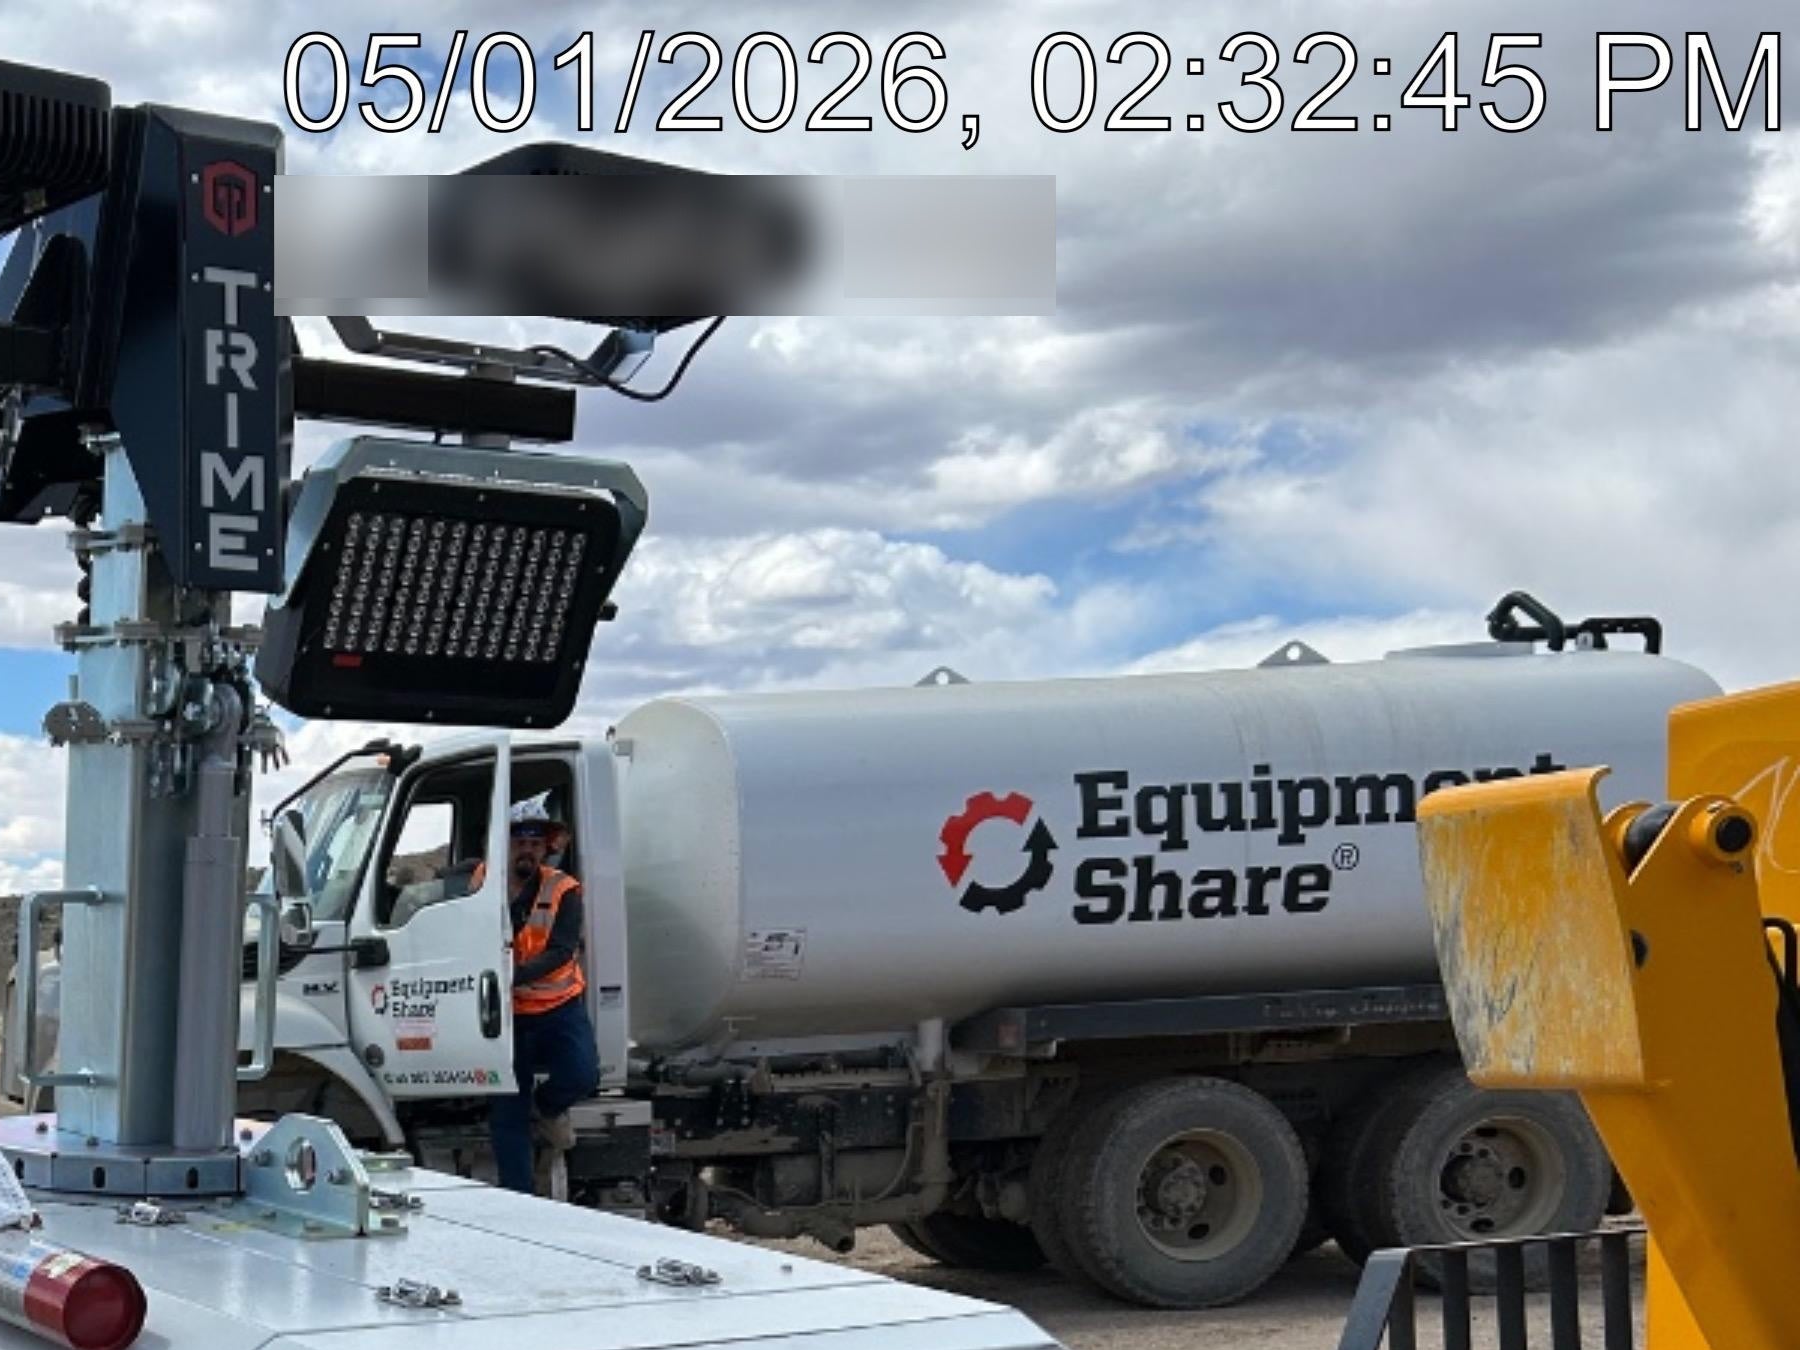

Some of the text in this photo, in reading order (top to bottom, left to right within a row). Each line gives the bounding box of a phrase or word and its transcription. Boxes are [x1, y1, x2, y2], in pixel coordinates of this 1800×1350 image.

[201, 265, 266, 572] TRIME
[1073, 752, 1566, 851] Equipm
[391, 974, 475, 999] Equipment
